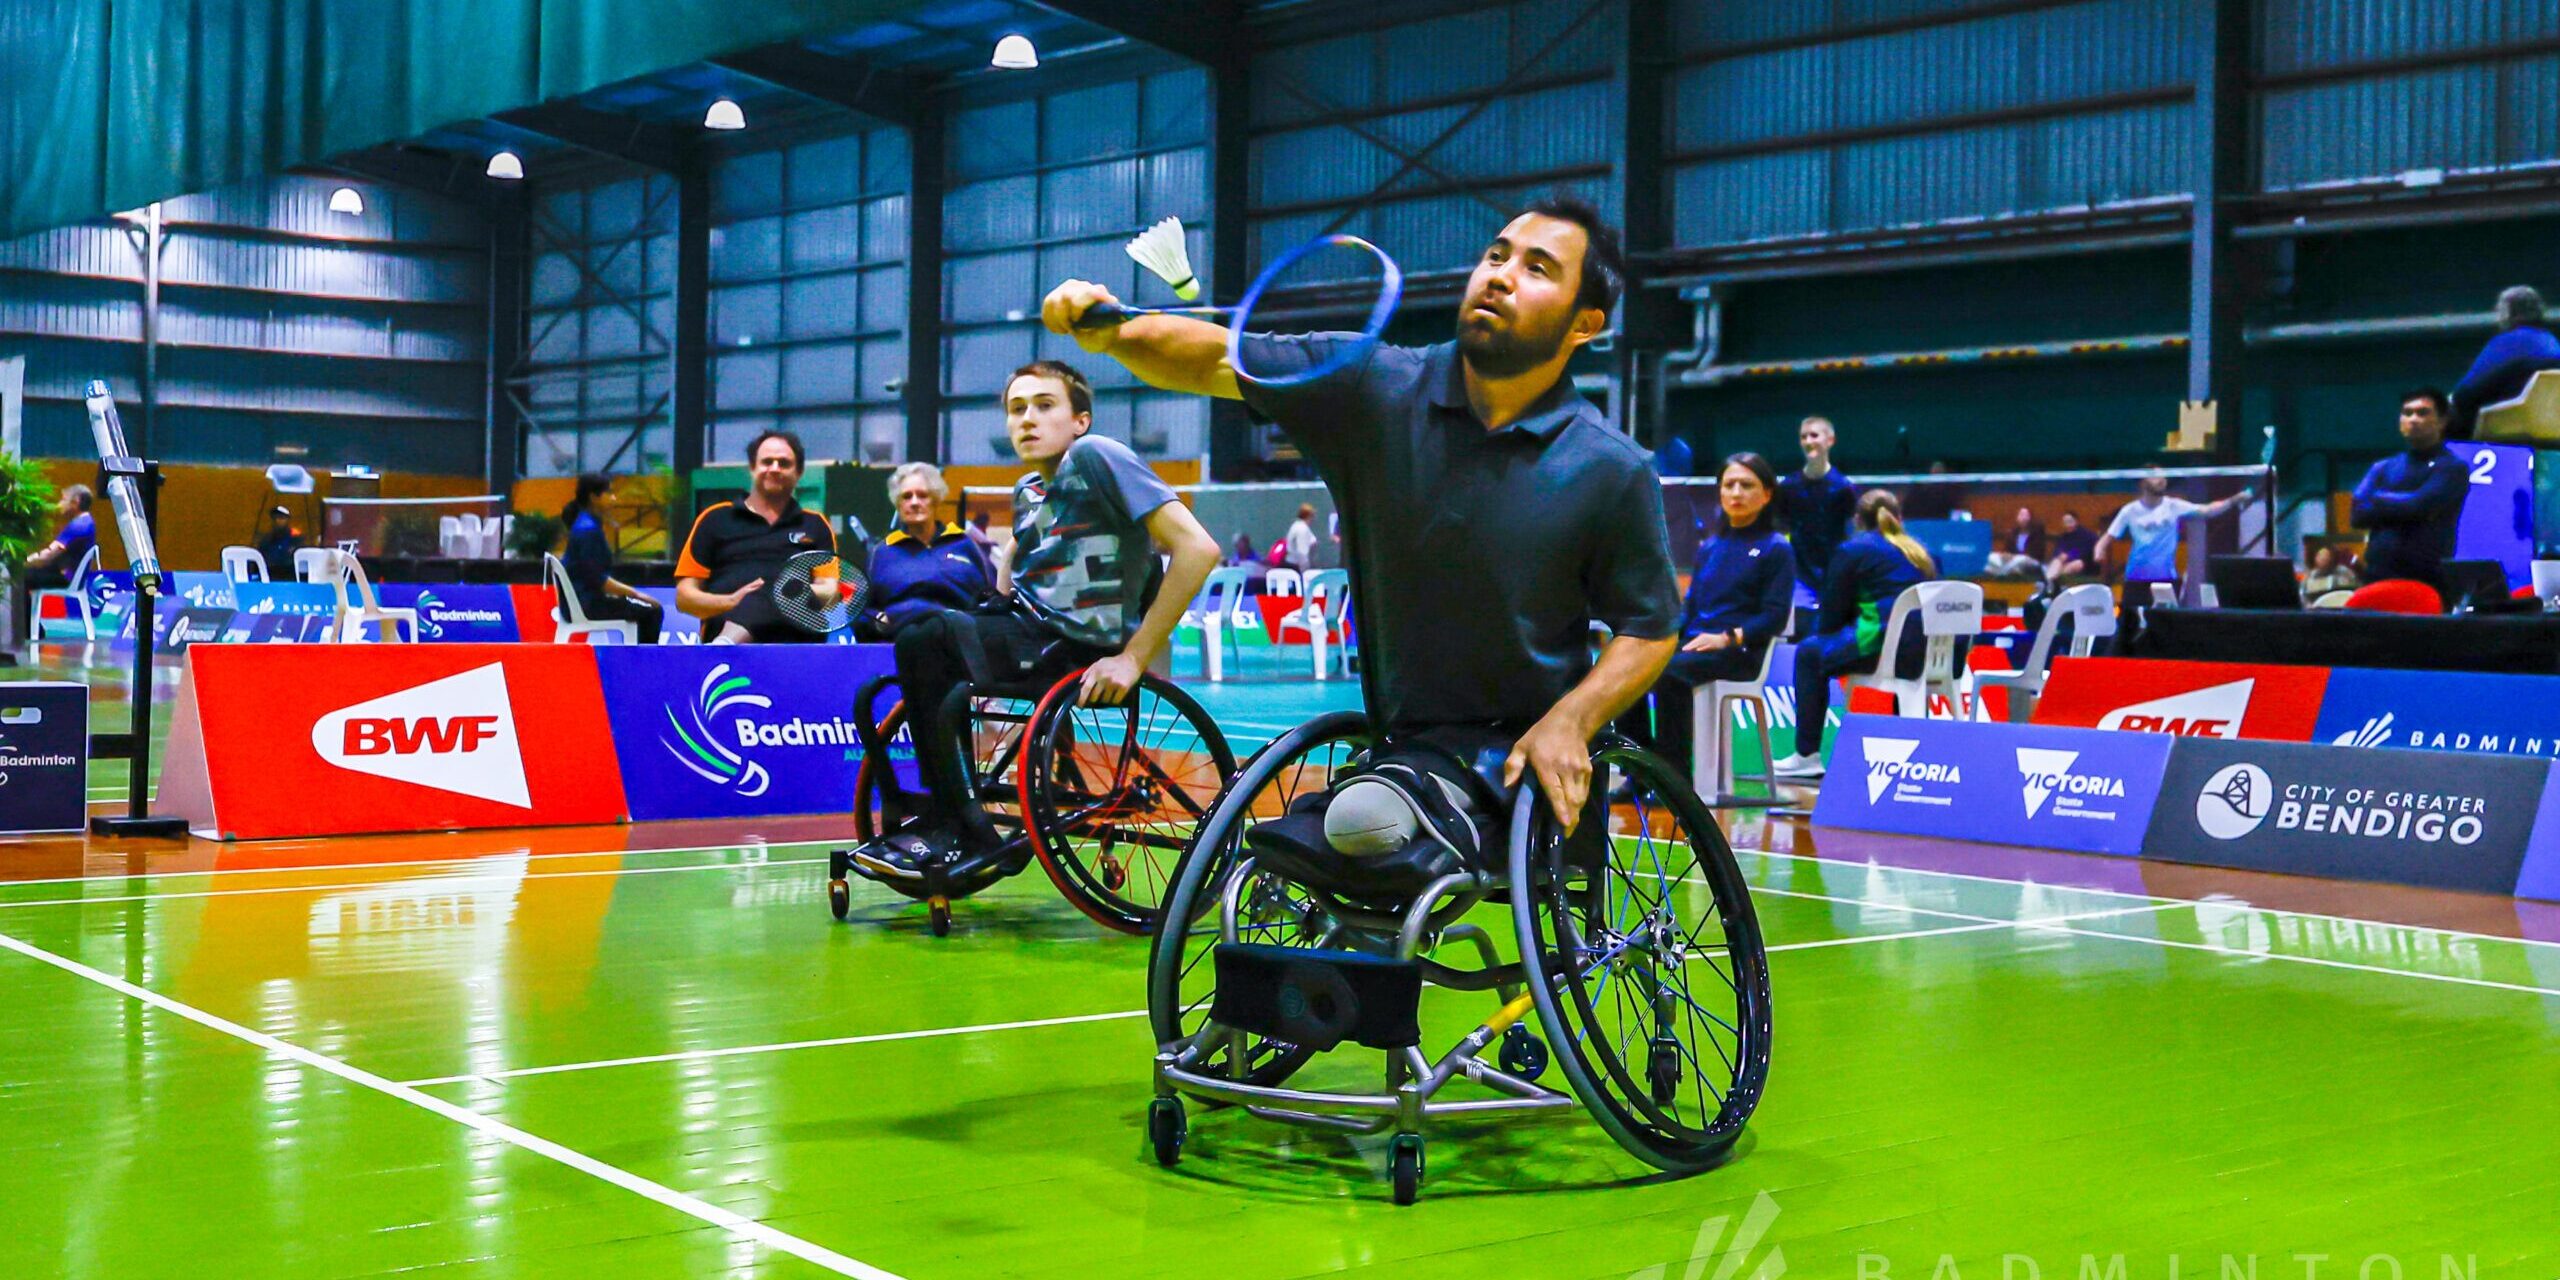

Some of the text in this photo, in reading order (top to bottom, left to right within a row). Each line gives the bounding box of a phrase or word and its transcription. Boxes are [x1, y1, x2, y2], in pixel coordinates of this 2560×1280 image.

[2469, 449, 2497, 485] 2
[430, 609, 502, 621] Badminton
[343, 716, 498, 756] BWF
[0, 755, 76, 767] Badminton
[1866, 760, 1961, 784] VICTORIA
[2021, 772, 2125, 797] VICTORIA
[2285, 784, 2485, 814] CITY OF GREATER
[2276, 801, 2483, 845] BENDIGO
